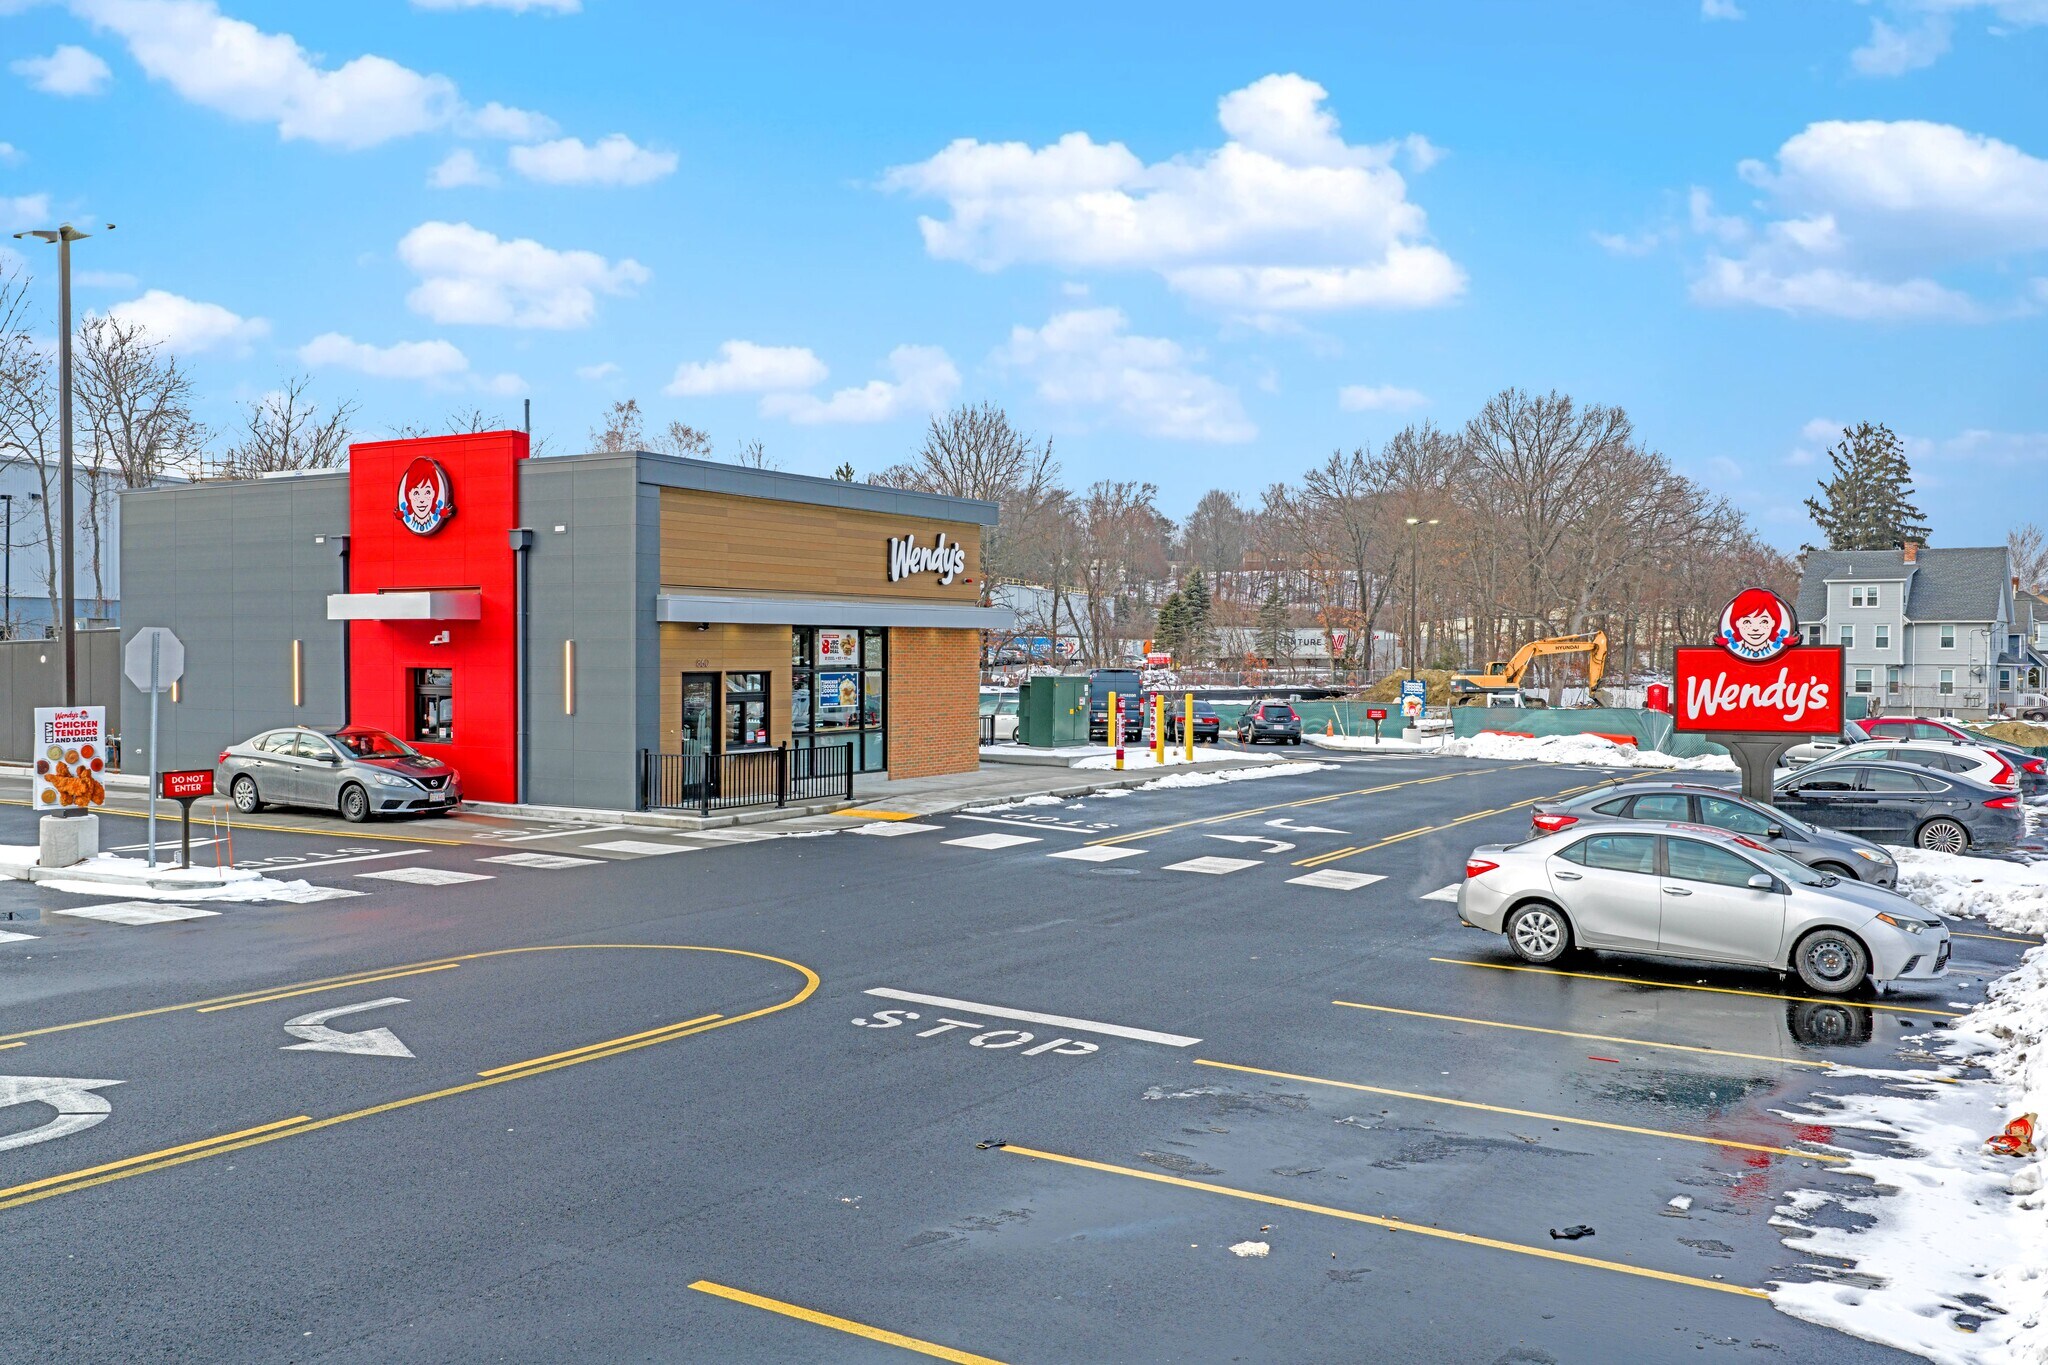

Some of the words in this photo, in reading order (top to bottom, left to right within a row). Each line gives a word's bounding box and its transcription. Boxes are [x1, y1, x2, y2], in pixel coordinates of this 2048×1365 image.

[889, 532, 965, 585] Wendy's
[822, 639, 830, 655] 8
[1687, 667, 1829, 722] Wendy's
[54, 711, 79, 721] Wendy's
[54, 720, 98, 729] CHICKEN
[45, 722, 54, 743] NEW
[54, 728, 98, 737] TENDERS
[171, 776, 185, 784] DO
[186, 774, 205, 783] NOT
[174, 783, 202, 793] ENTER
[1001, 814, 1119, 829] STOP
[850, 1009, 1100, 1056] STOP
